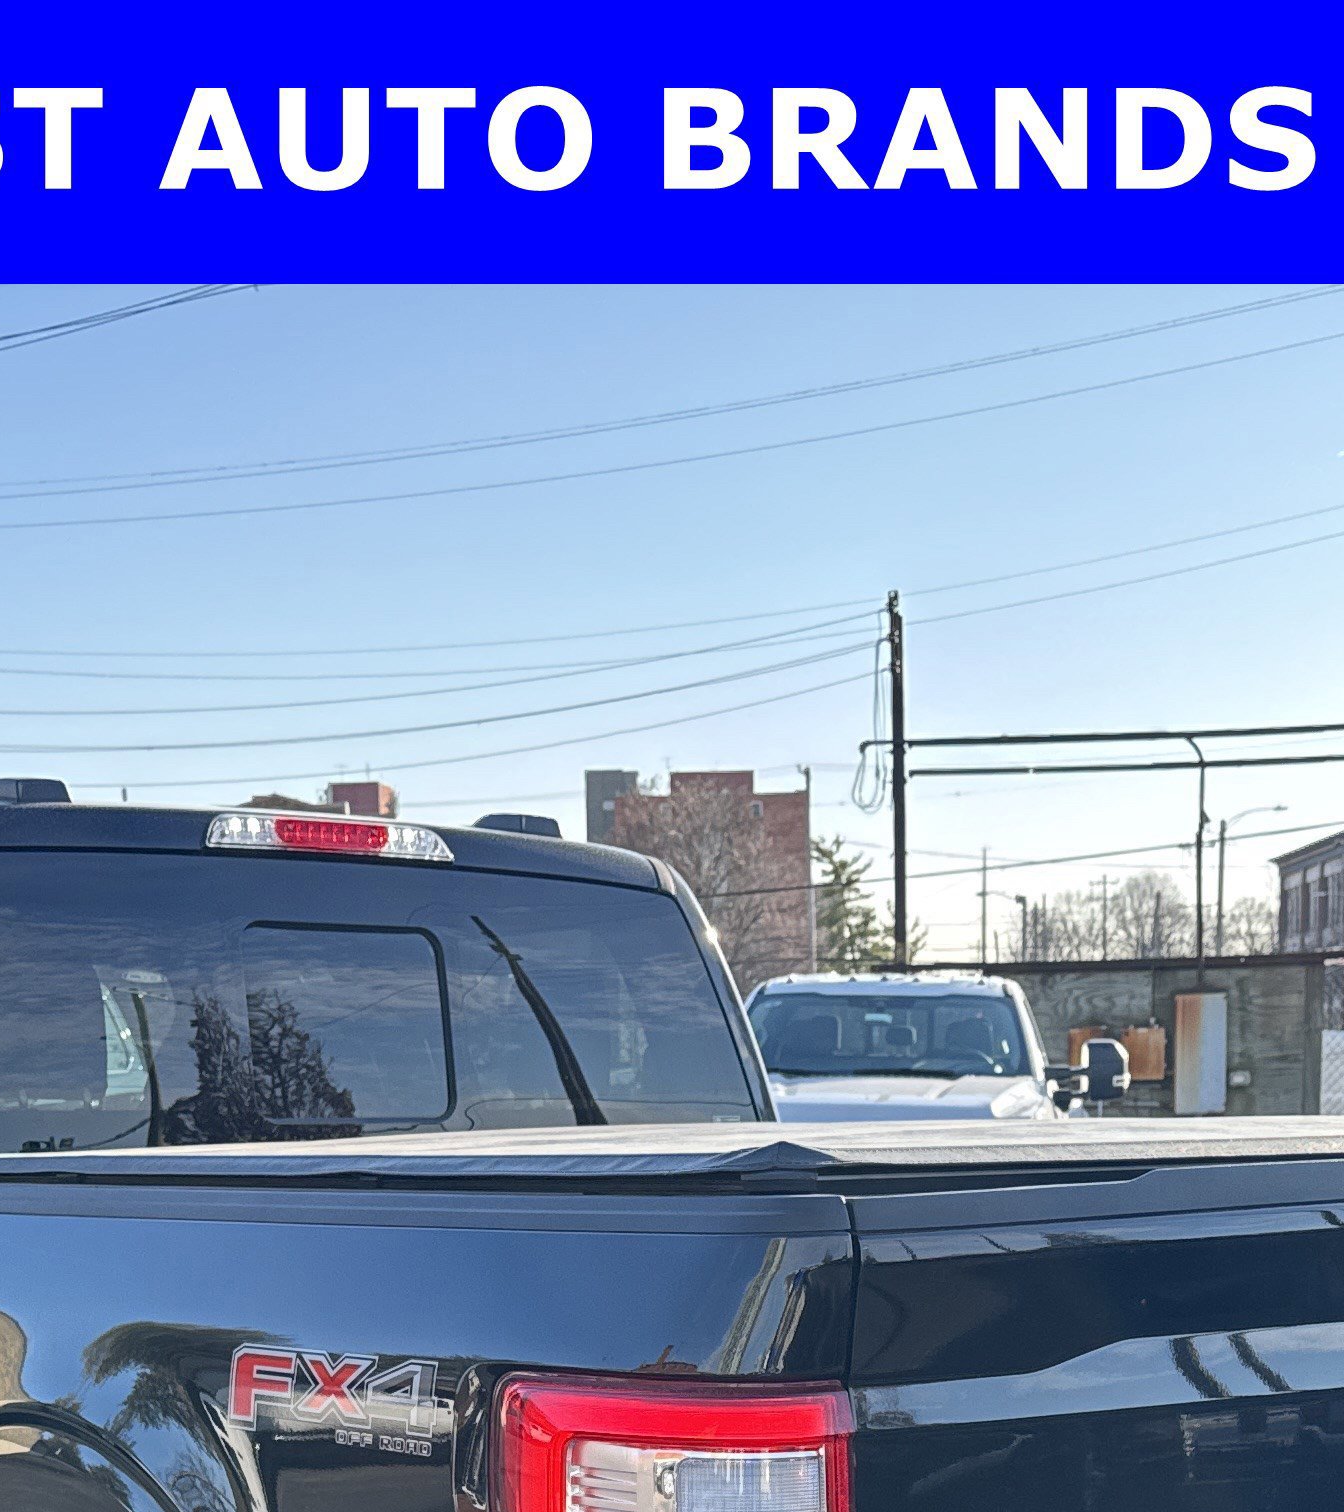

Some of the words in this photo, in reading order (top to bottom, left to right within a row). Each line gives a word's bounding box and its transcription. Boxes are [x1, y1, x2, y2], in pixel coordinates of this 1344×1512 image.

[228, 1343, 438, 1438] FX4
[334, 1428, 373, 1448] OFF
[379, 1435, 432, 1457] ROAD
